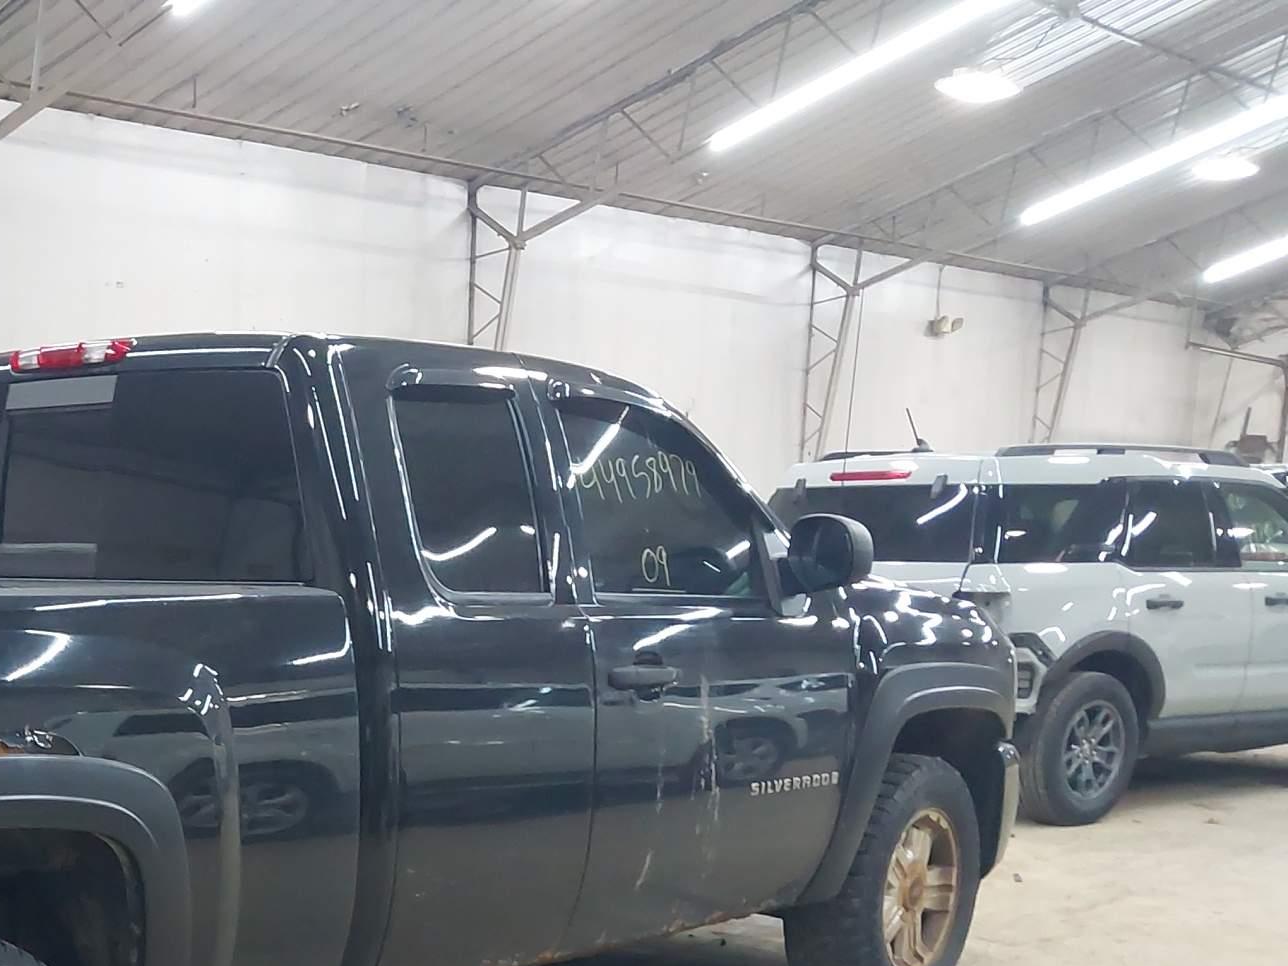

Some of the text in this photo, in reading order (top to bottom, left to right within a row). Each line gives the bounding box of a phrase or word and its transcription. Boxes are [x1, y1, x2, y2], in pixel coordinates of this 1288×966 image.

[579, 451, 702, 504] 44958979
[641, 546, 671, 586] 09
[750, 773, 830, 797] SILVERADO
